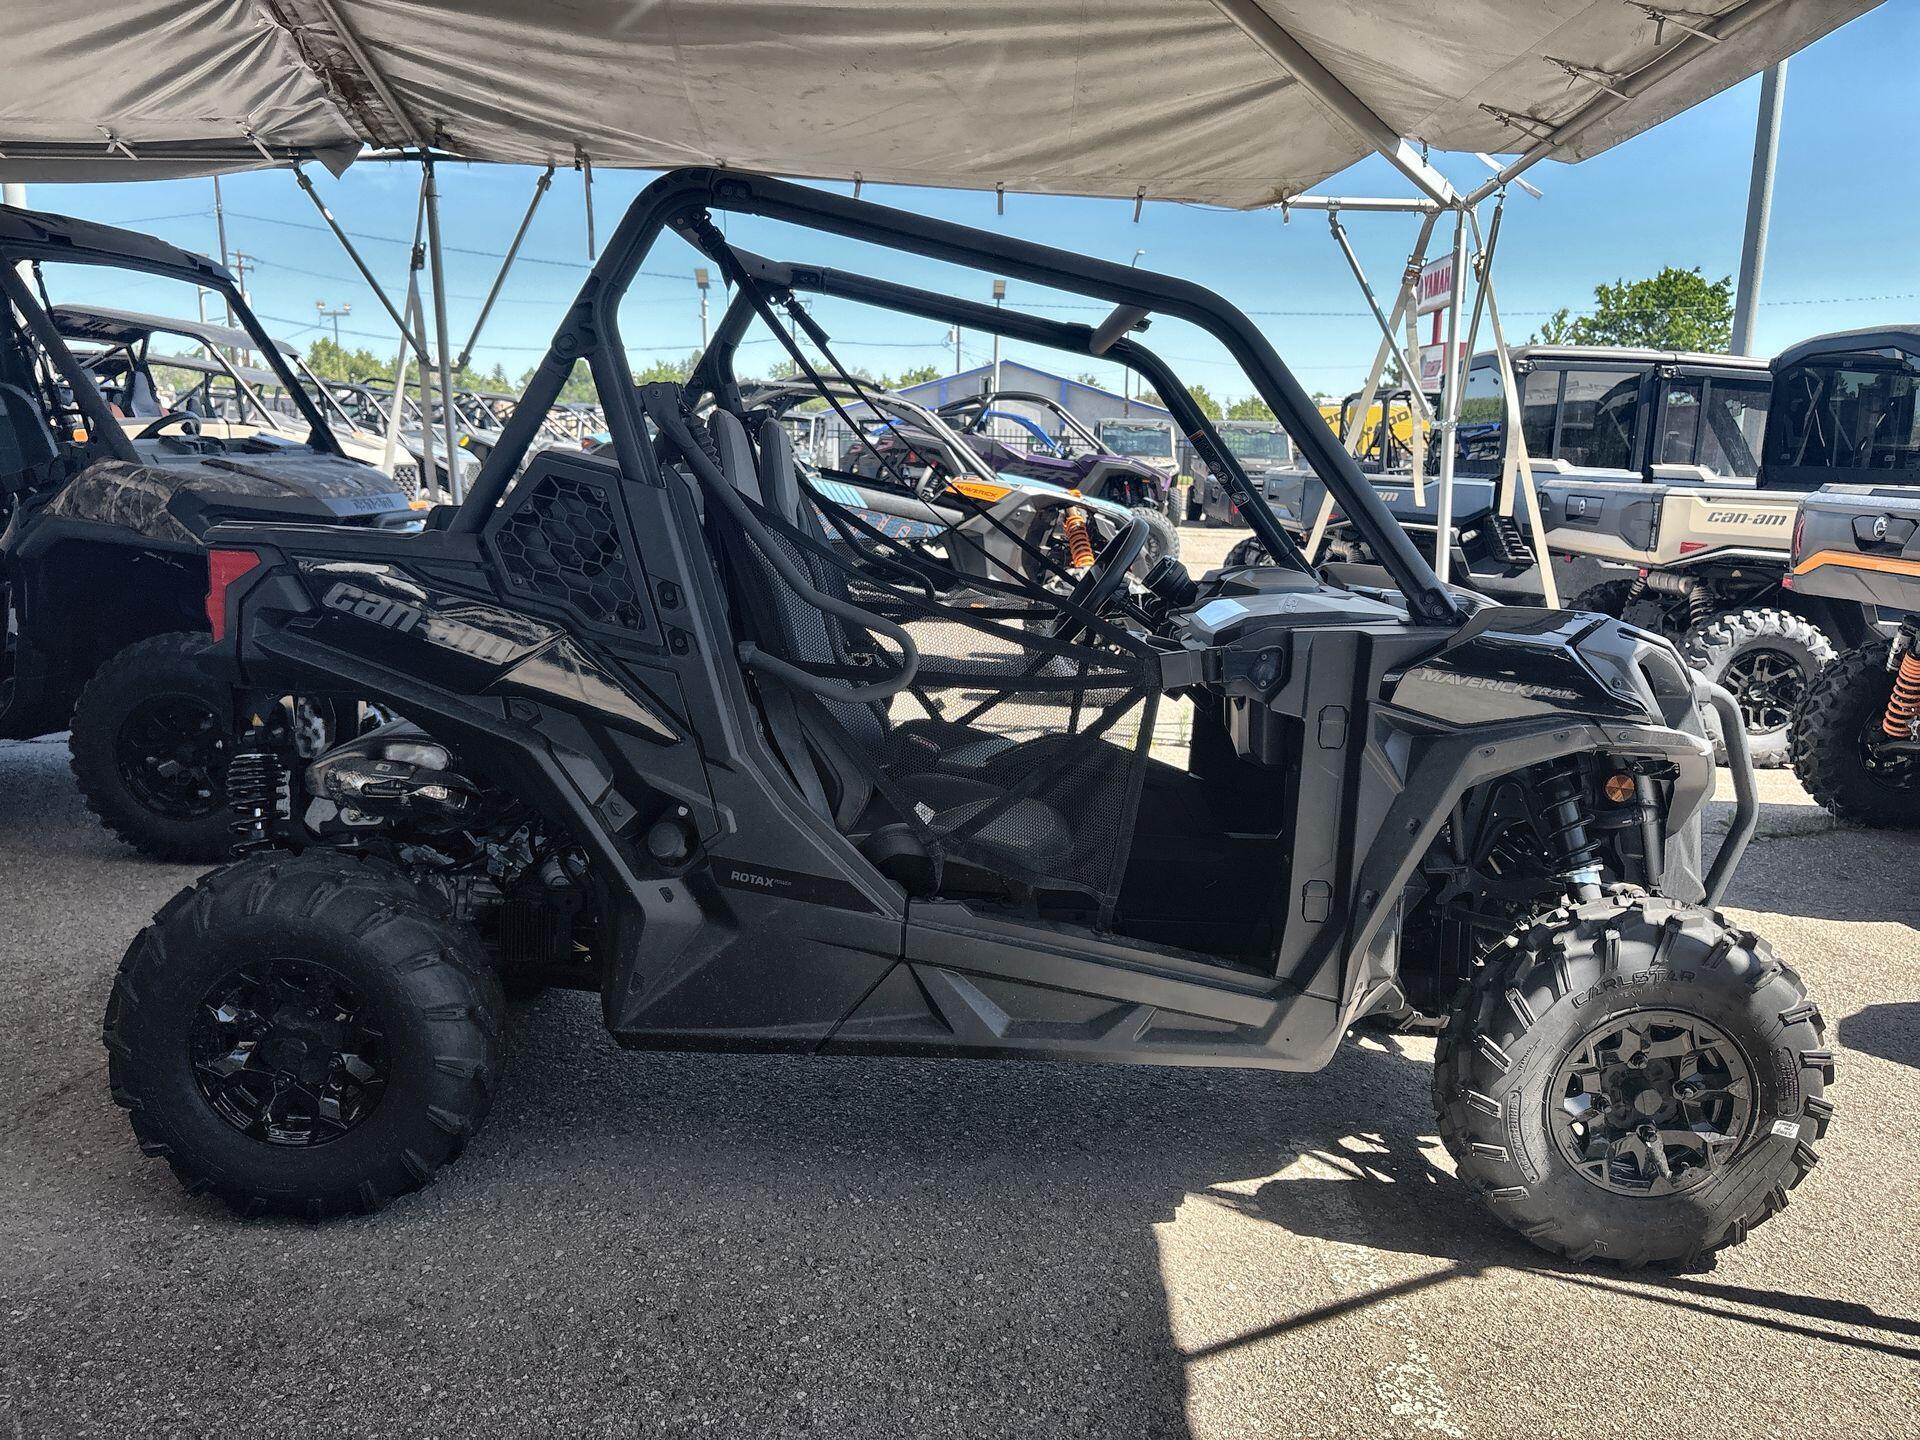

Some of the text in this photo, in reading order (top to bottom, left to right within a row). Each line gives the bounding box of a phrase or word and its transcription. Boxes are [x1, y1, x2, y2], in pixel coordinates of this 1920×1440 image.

[1424, 265, 1451, 300] YAMAH
[956, 484, 999, 498] MAVERICK
[1707, 511, 1787, 526] can-am
[322, 581, 515, 667] can-am
[1420, 667, 1532, 698] MAVERICK
[730, 870, 775, 888] ROTAX
[1571, 968, 1697, 1010] CARLSTAR
